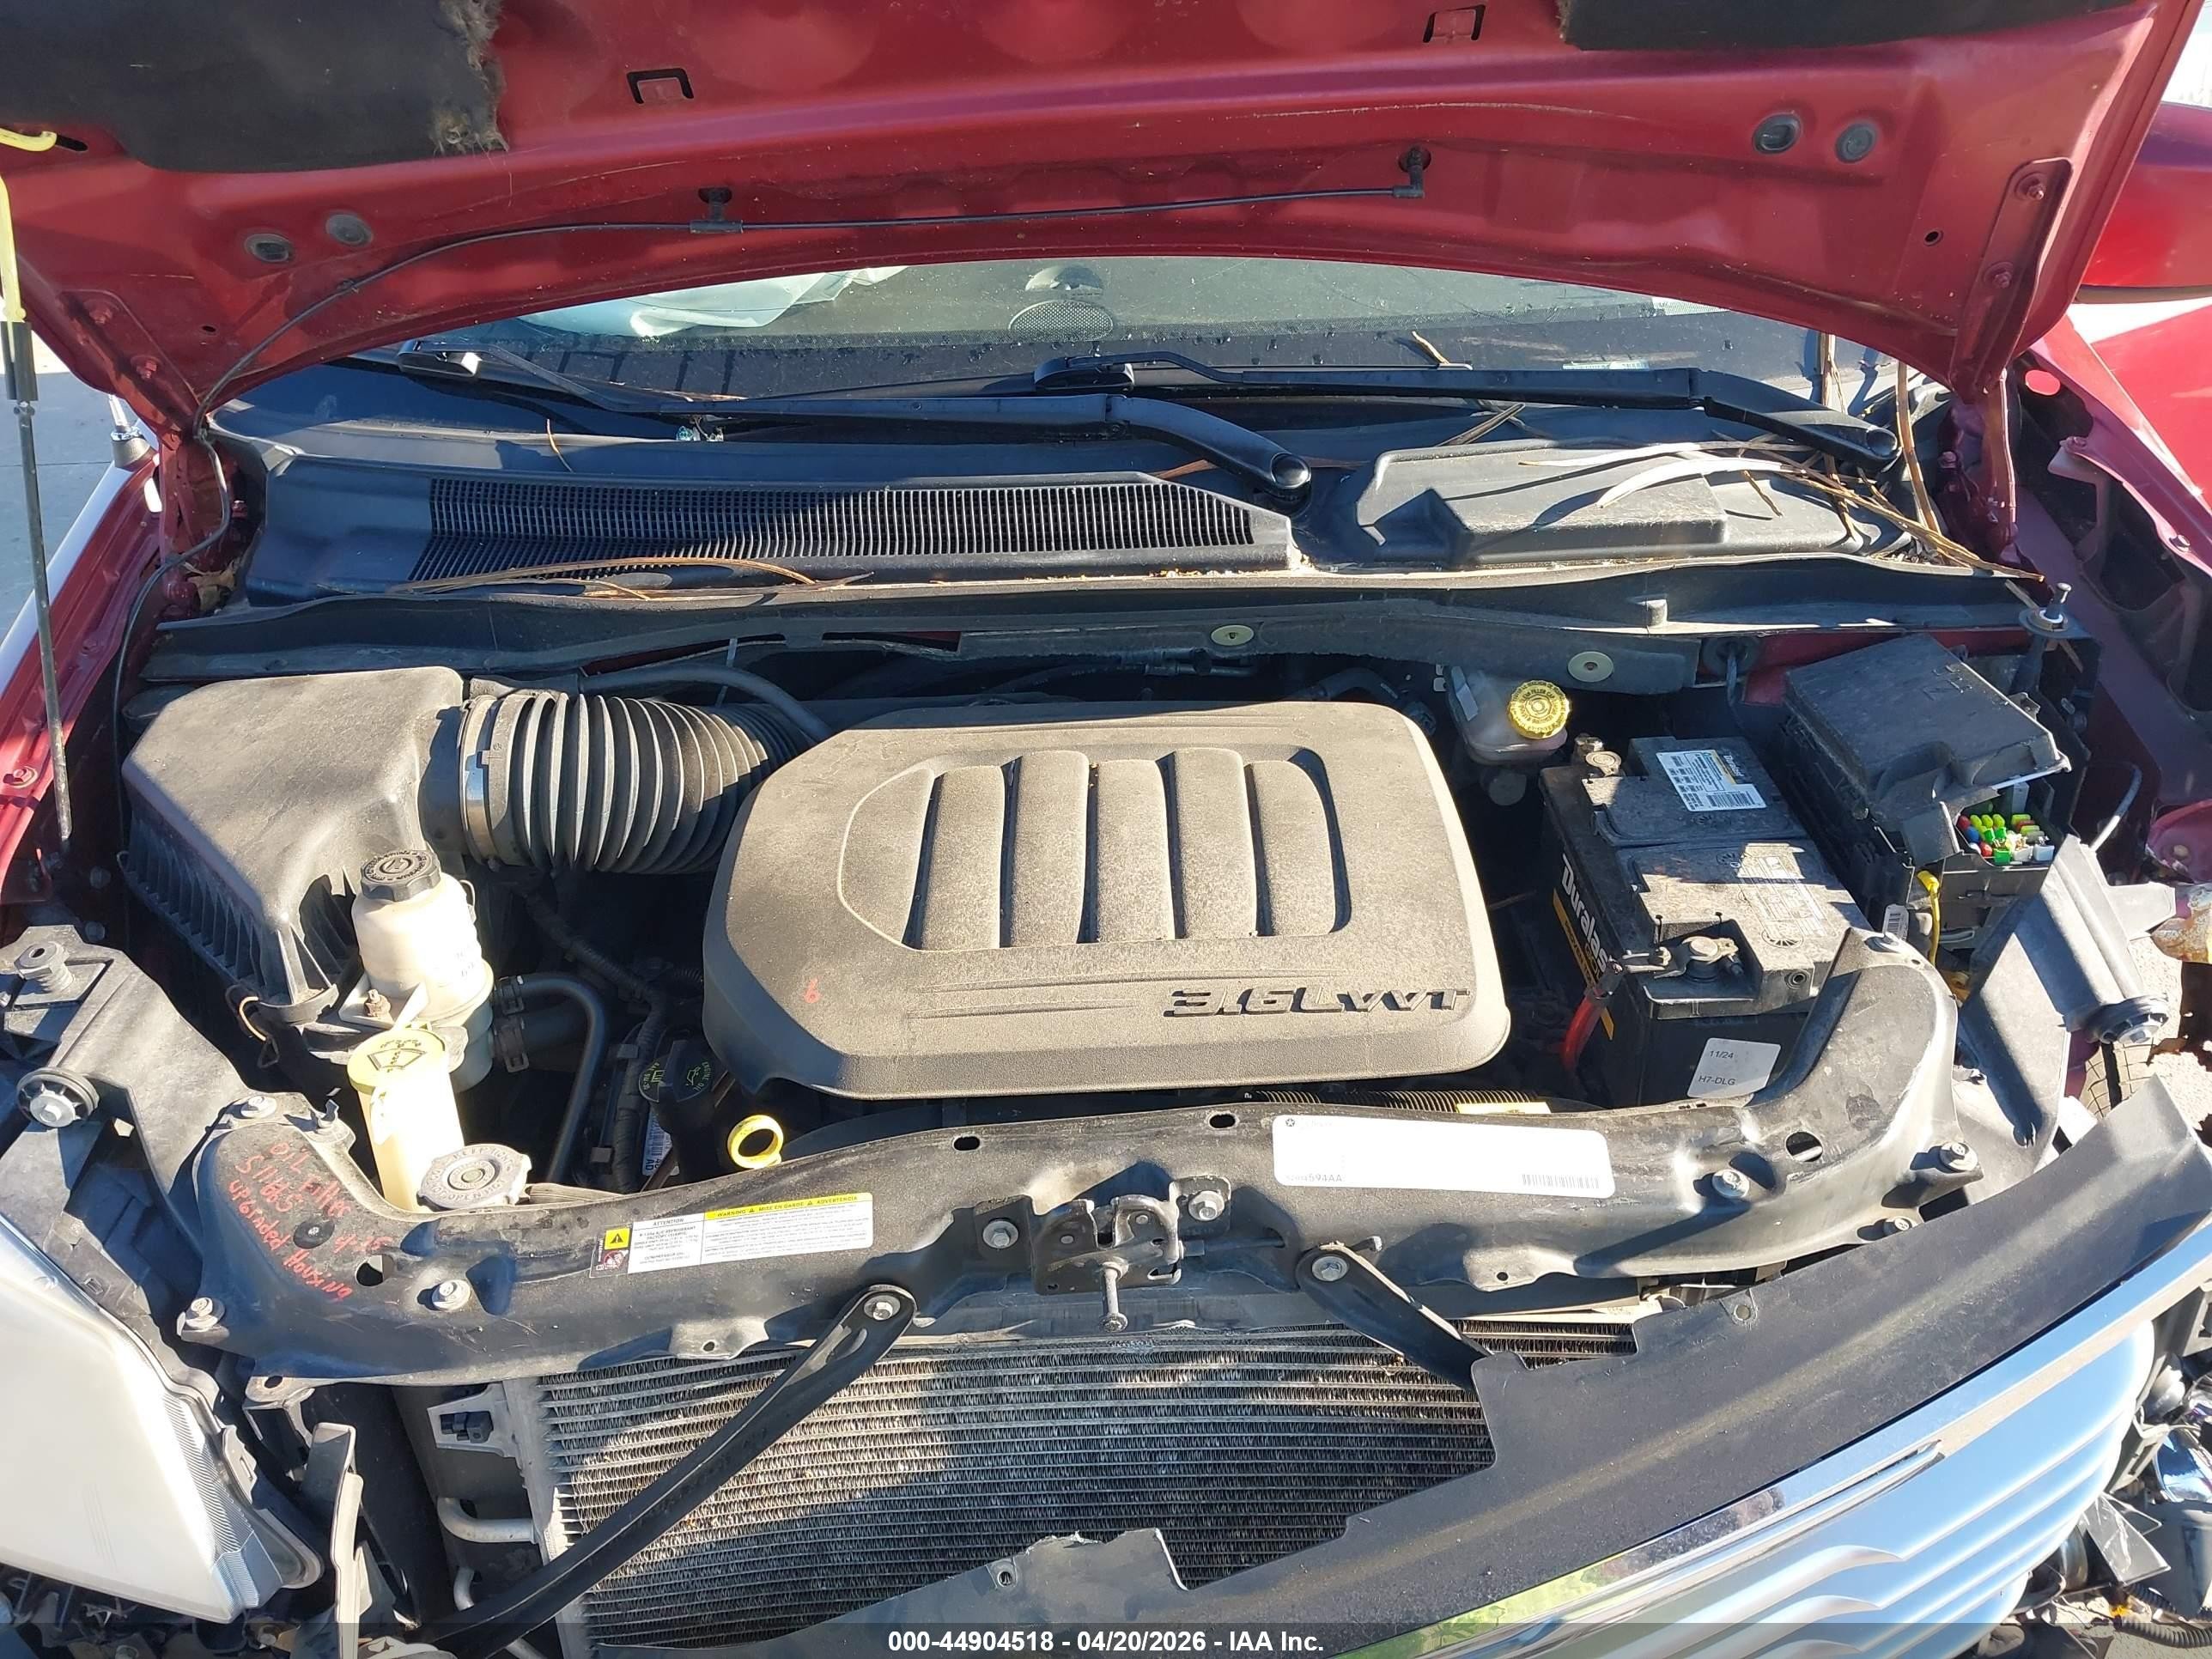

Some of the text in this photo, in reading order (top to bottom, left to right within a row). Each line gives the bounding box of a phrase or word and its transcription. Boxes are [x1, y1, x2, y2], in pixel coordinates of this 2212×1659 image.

[1561, 853, 1608, 974] Duralas
[1709, 1050, 1735, 1060] 11/24
[1698, 1075, 1736, 1086] H7-DLG
[717, 1209, 746, 1218] WARNING
[817, 1195, 858, 1204] ADVERTENCIA
[653, 1218, 684, 1226] ATTENTION
